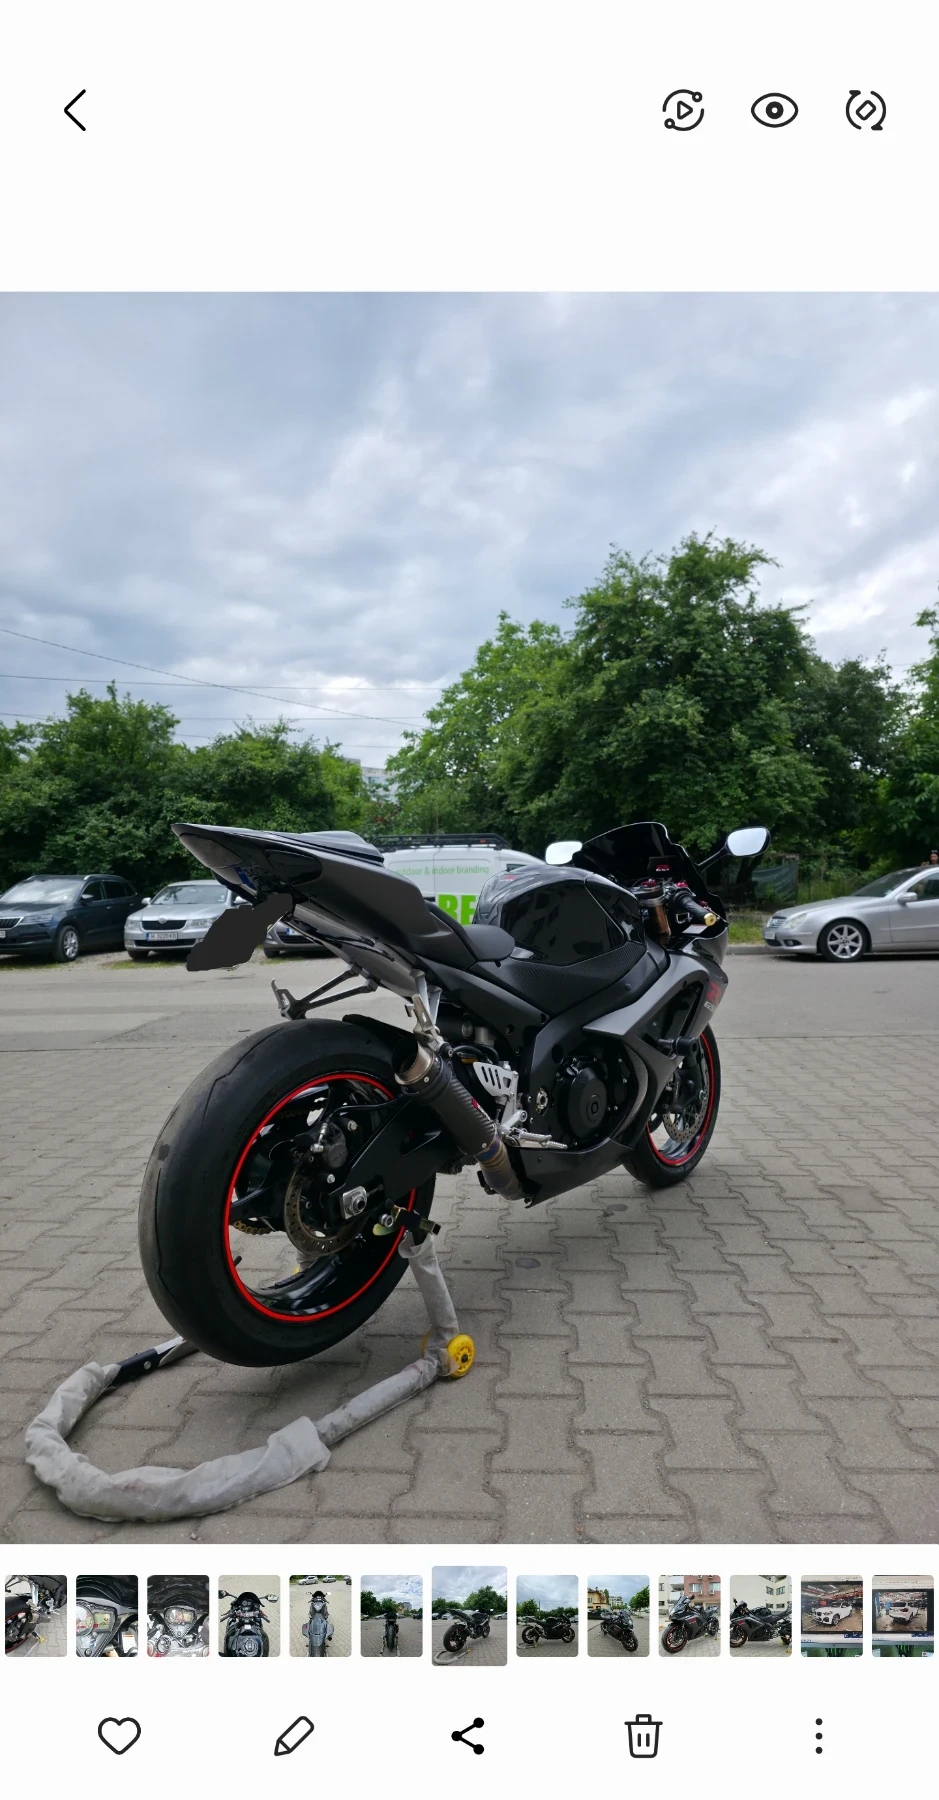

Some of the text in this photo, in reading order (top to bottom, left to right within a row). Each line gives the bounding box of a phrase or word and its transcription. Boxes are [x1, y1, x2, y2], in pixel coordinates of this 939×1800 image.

[424, 866, 430, 875] &
[432, 865, 455, 875] indoor
[457, 865, 489, 875] branding
